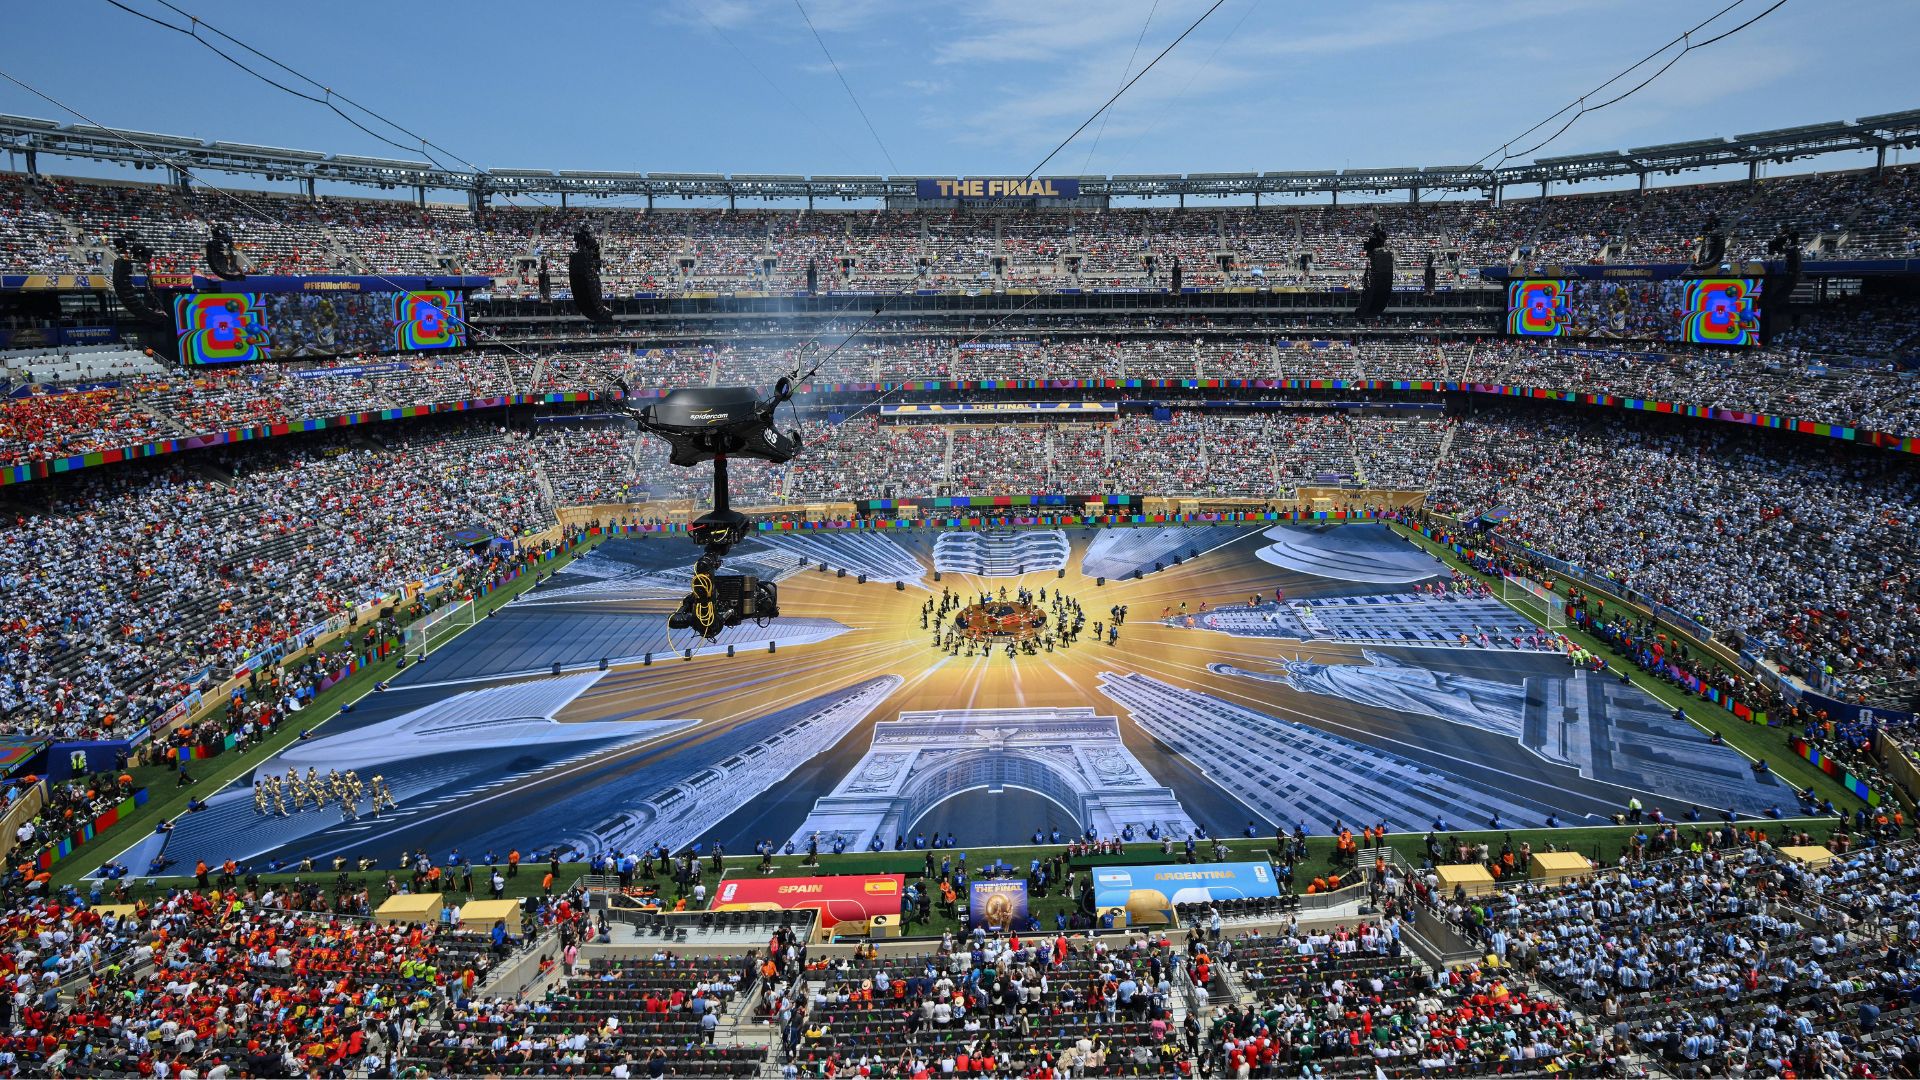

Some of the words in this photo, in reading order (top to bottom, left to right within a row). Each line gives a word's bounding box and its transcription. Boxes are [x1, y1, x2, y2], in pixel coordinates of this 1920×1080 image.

[936, 180, 984, 196] THE
[988, 180, 1058, 196] FINAL
[304, 282, 360, 290] #FIFAWorldCup
[1155, 871, 1235, 880] ARGENTINA
[778, 884, 823, 893] SPAIN
[180, 1037, 189, 1045] 10
